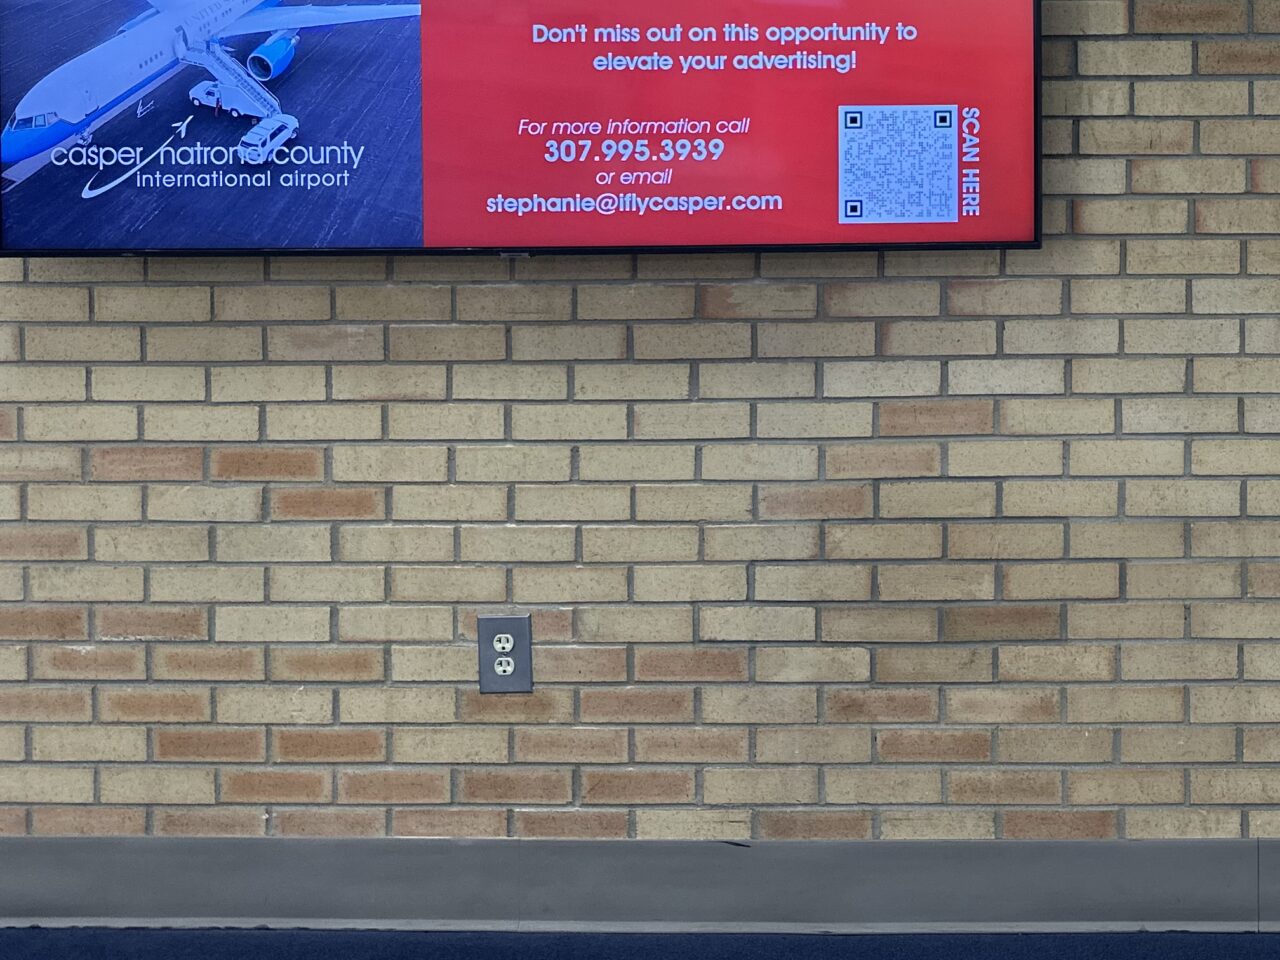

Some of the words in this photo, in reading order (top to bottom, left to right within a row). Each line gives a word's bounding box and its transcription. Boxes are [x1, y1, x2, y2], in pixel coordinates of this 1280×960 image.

[533, 24, 587, 42] Don't
[594, 24, 640, 42] miss
[646, 24, 682, 41] out
[688, 27, 716, 41] on
[723, 24, 758, 41] this
[766, 23, 890, 45] opportunity
[896, 23, 917, 40] to
[593, 52, 673, 70] elevate
[679, 55, 727, 73] your
[733, 51, 856, 73] advertising!
[519, 119, 547, 134] For
[552, 121, 601, 134] more
[607, 118, 710, 134] information
[713, 118, 750, 133] call
[962, 107, 980, 162] SCAN
[51, 142, 144, 166] casper
[273, 141, 365, 168] county
[545, 139, 724, 162] 307.995.3939
[136, 169, 272, 188] international
[279, 169, 350, 189] airport
[596, 172, 615, 184] or
[620, 169, 672, 184] email
[963, 170, 979, 216] HERE
[487, 193, 782, 216] stephanie@iflycasper.com
